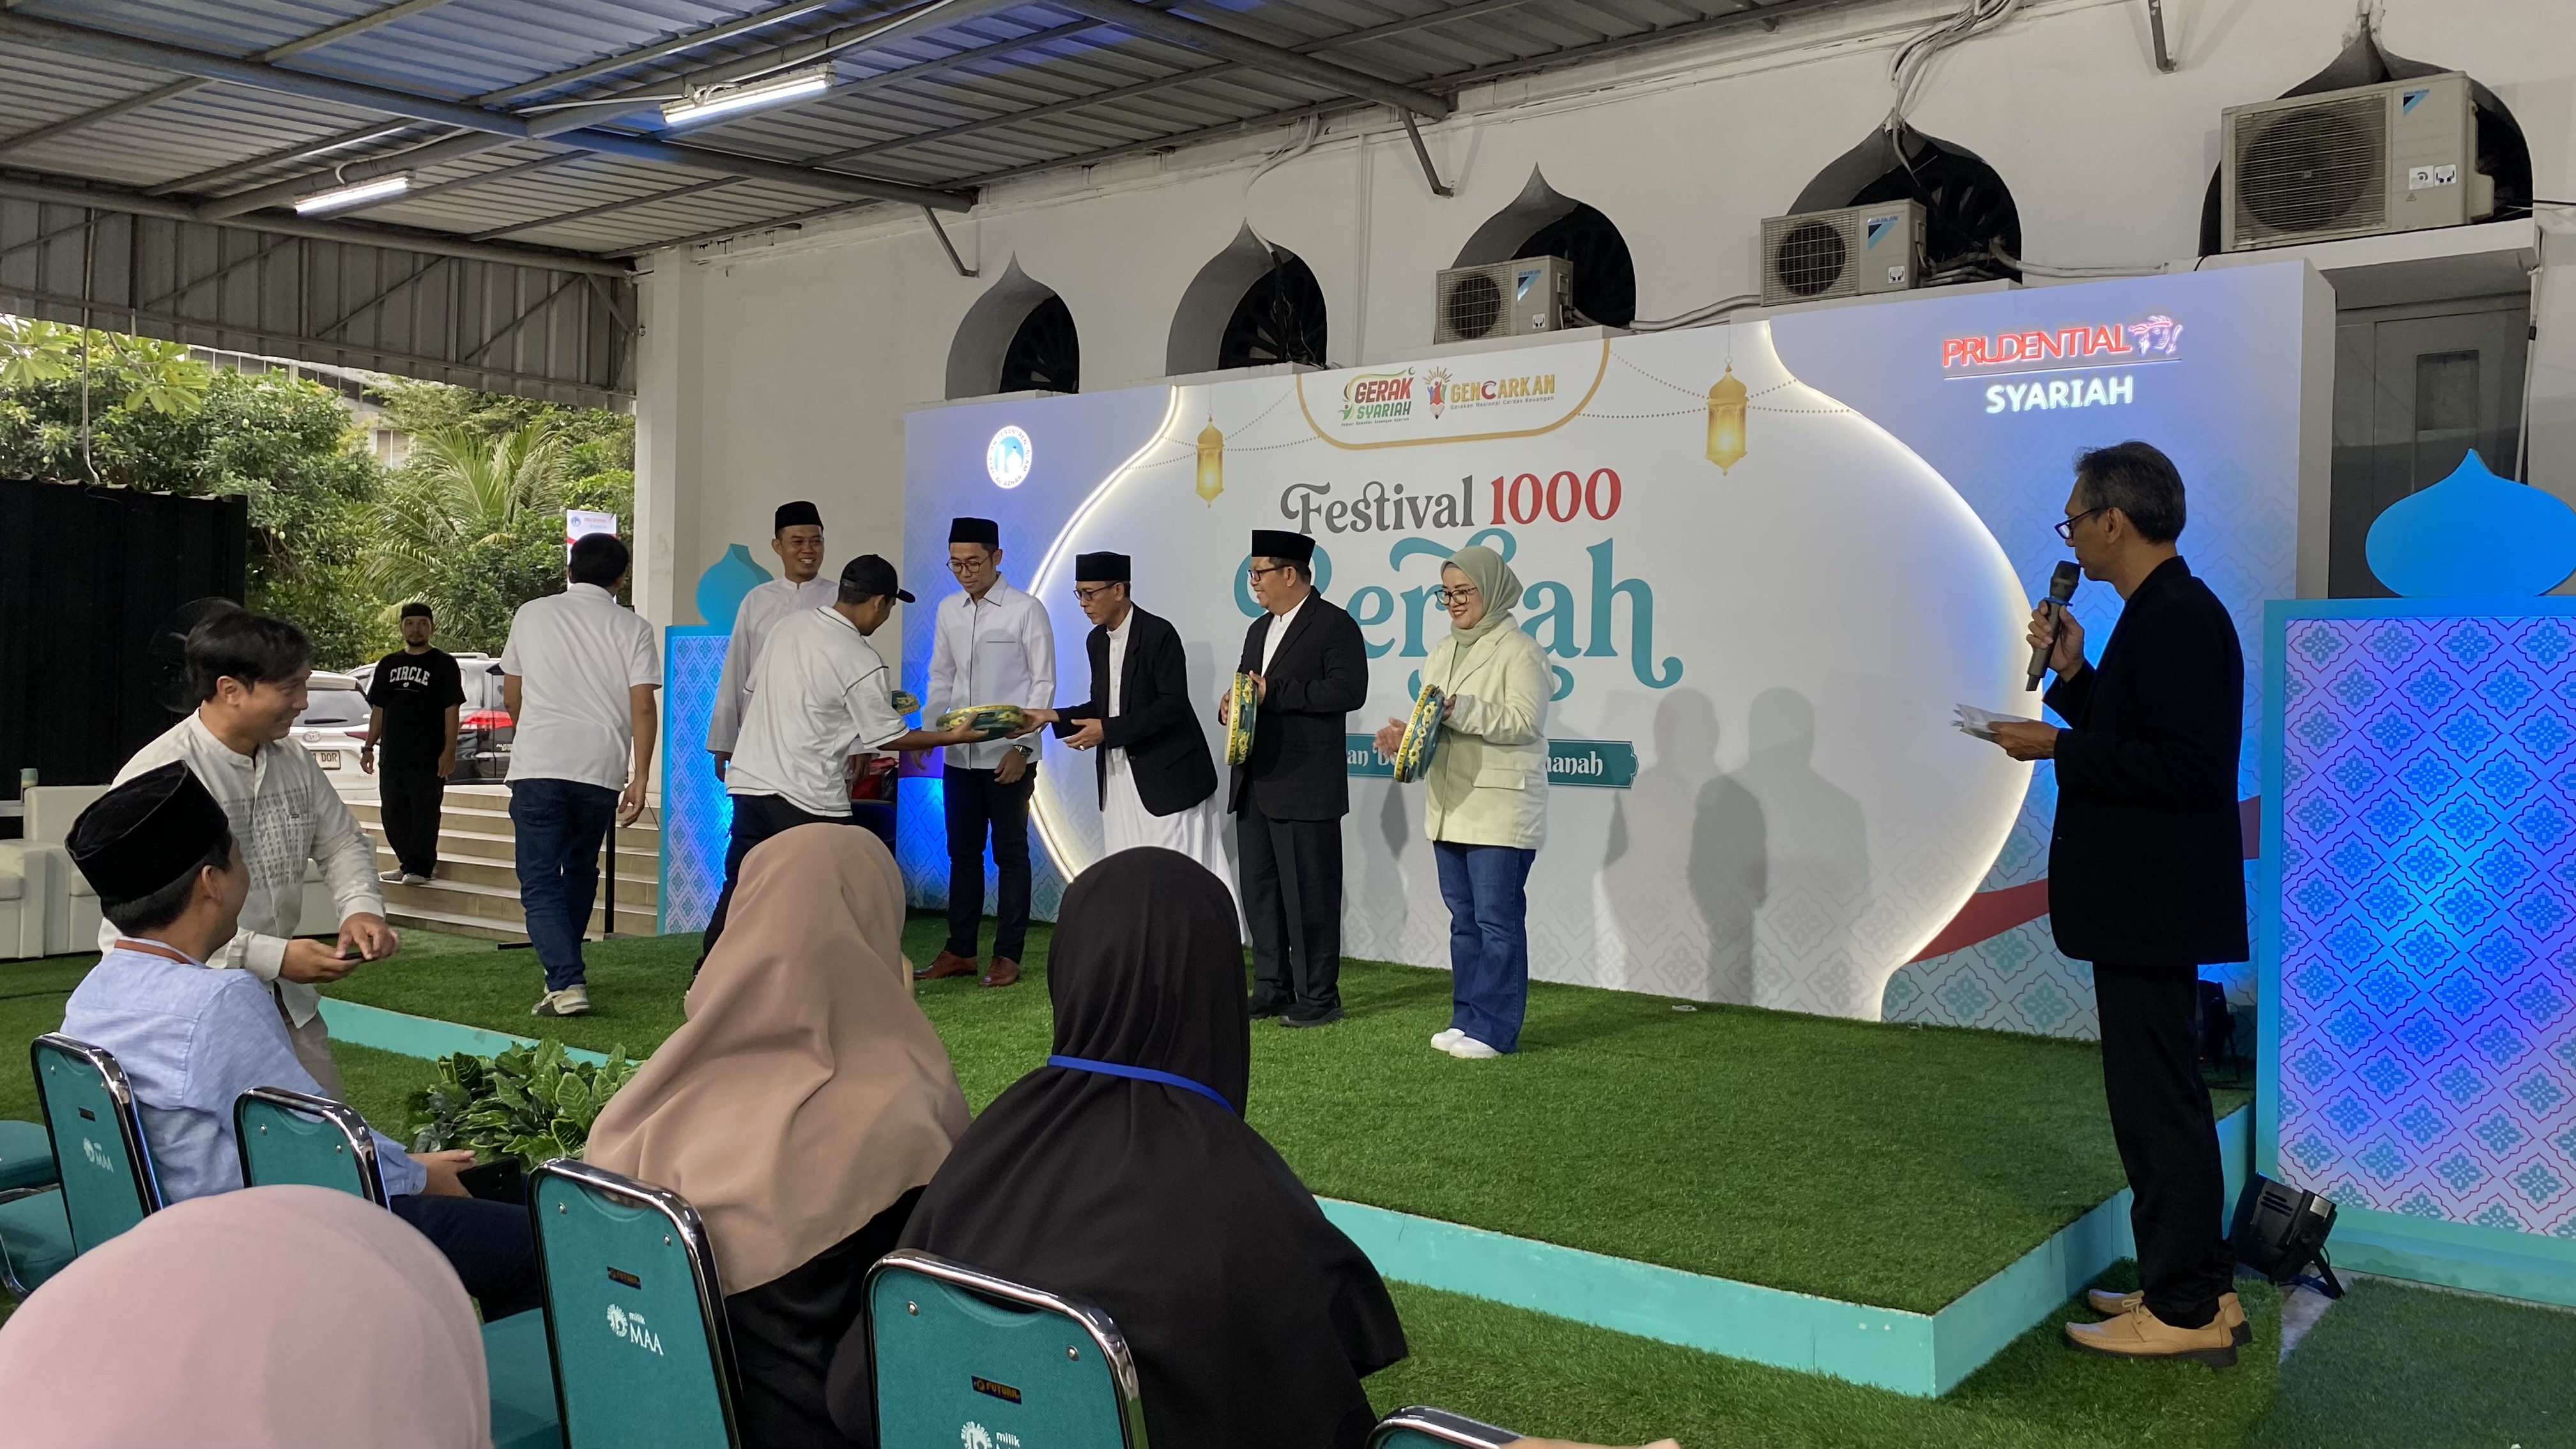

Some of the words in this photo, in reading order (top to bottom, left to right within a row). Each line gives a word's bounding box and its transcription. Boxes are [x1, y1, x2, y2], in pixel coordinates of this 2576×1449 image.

[1943, 324, 2133, 367] PRUDENTIAL
[1354, 377, 1414, 404] GERAK
[1450, 374, 1555, 404] GENCARKAN
[1986, 374, 2133, 413] SYARIAH
[1356, 401, 1412, 420] SYARIAH
[1280, 475, 1475, 535] Festival
[1491, 467, 1621, 526] 1000
[389, 666, 431, 686] CIRCLE
[321, 753, 337, 762] DOR
[630, 1322, 664, 1356] MAA
[997, 1432, 1020, 1448] milik
